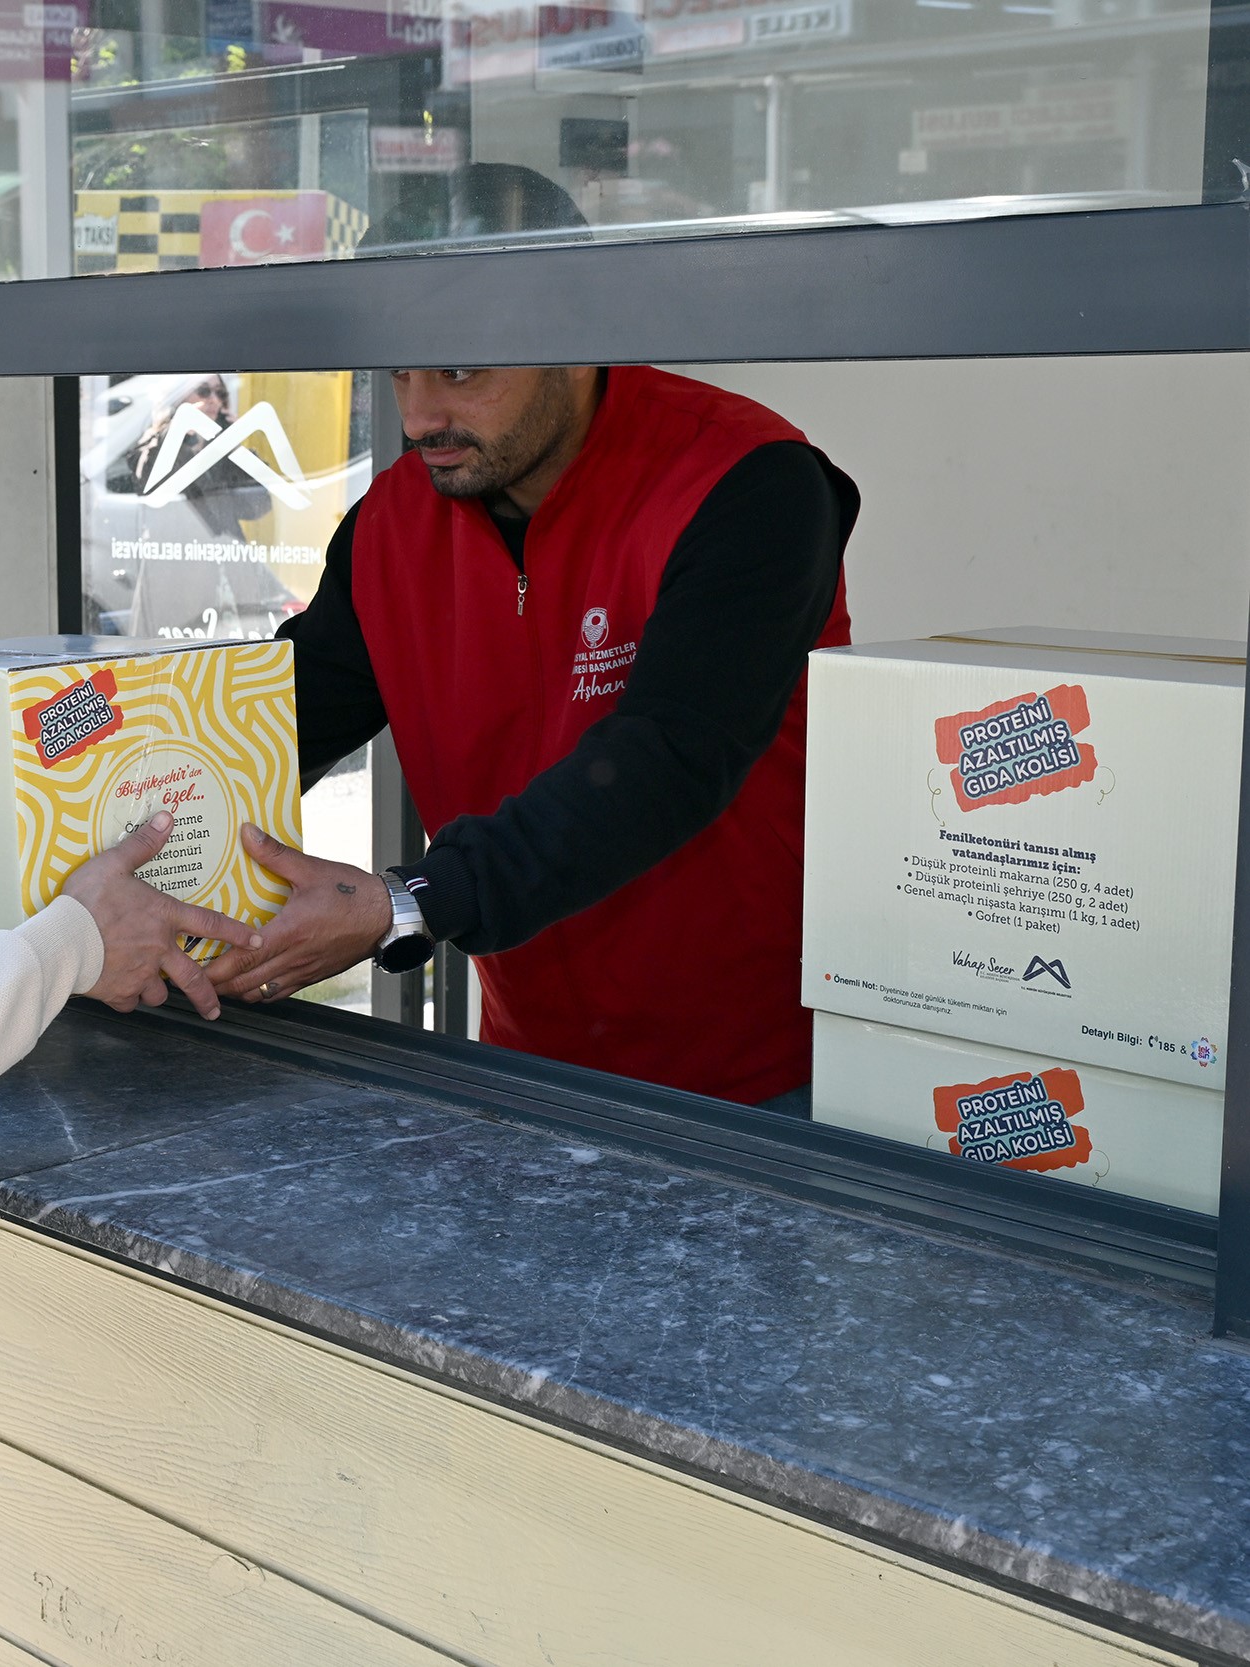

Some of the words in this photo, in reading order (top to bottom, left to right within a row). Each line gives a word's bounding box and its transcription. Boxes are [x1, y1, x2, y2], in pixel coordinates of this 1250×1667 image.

[589, 641, 637, 661] HİZMETLER
[40, 682, 94, 725] PROTEİNİ
[42, 695, 106, 743] AZALTILMIŞ
[962, 699, 1049, 746] PROTEİNİ
[46, 733, 76, 757] GIDA
[75, 706, 113, 739] KOLİSİ
[962, 723, 1068, 773] AZALTILMIŞ
[965, 769, 1013, 795] GIDA
[1014, 742, 1077, 780] KOLİSİ
[162, 783, 205, 814] özel...
[186, 828, 211, 841] olan
[939, 829, 1021, 851] Fenilketonüri
[1023, 841, 1059, 856] tanısı
[1062, 847, 1097, 864] almış
[911, 855, 947, 870] Düşük
[949, 862, 997, 878] proteinli
[999, 870, 1050, 886] makarna
[1052, 875, 1078, 890] (250
[1080, 882, 1091, 894] g,
[1094, 882, 1101, 893] 4
[1104, 885, 1134, 899] adet)
[952, 848, 1049, 870] vatandaşlarımız
[1052, 860, 1081, 875] için:
[160, 876, 201, 893] hizmet.
[915, 870, 950, 886] Düşük
[952, 878, 1001, 894] proteinli
[1003, 885, 1045, 901] şehriye
[1048, 890, 1073, 904] (250
[1075, 897, 1086, 909] g,
[1088, 897, 1096, 908] 2
[1098, 900, 1129, 914] adet)
[903, 883, 935, 898] Genel
[937, 890, 974, 905] amaçlı
[977, 896, 1016, 911] nişasta
[1019, 901, 1066, 919] karışımı
[1068, 909, 1078, 921] (1
[1081, 911, 1098, 926] kg,
[1101, 914, 1107, 926] 1
[1110, 918, 1140, 932] adet)
[975, 909, 1011, 925] Gofret
[1013, 915, 1022, 928] (1
[1025, 919, 1061, 934] paket)
[952, 950, 986, 977] Vahap
[833, 973, 861, 987] Önemli
[862, 980, 878, 991] Not:
[879, 984, 909, 997] Diyetinize
[910, 991, 924, 1000] özel
[924, 994, 946, 1004] günlük
[947, 998, 971, 1009] tüketim
[995, 1007, 1008, 1016] için
[882, 995, 921, 1009] doktorunuza
[1081, 1025, 1114, 1041] Detaylı
[1117, 1032, 1143, 1047] Bilgi:
[1158, 1041, 1176, 1053] 185
[1179, 1045, 1188, 1055] &
[960, 1080, 1044, 1117] PROTEİNİ
[960, 1104, 1063, 1143] AZALTILMIŞ
[964, 1142, 1009, 1162] GIDA
[1011, 1123, 1072, 1154] KOLİSİ
